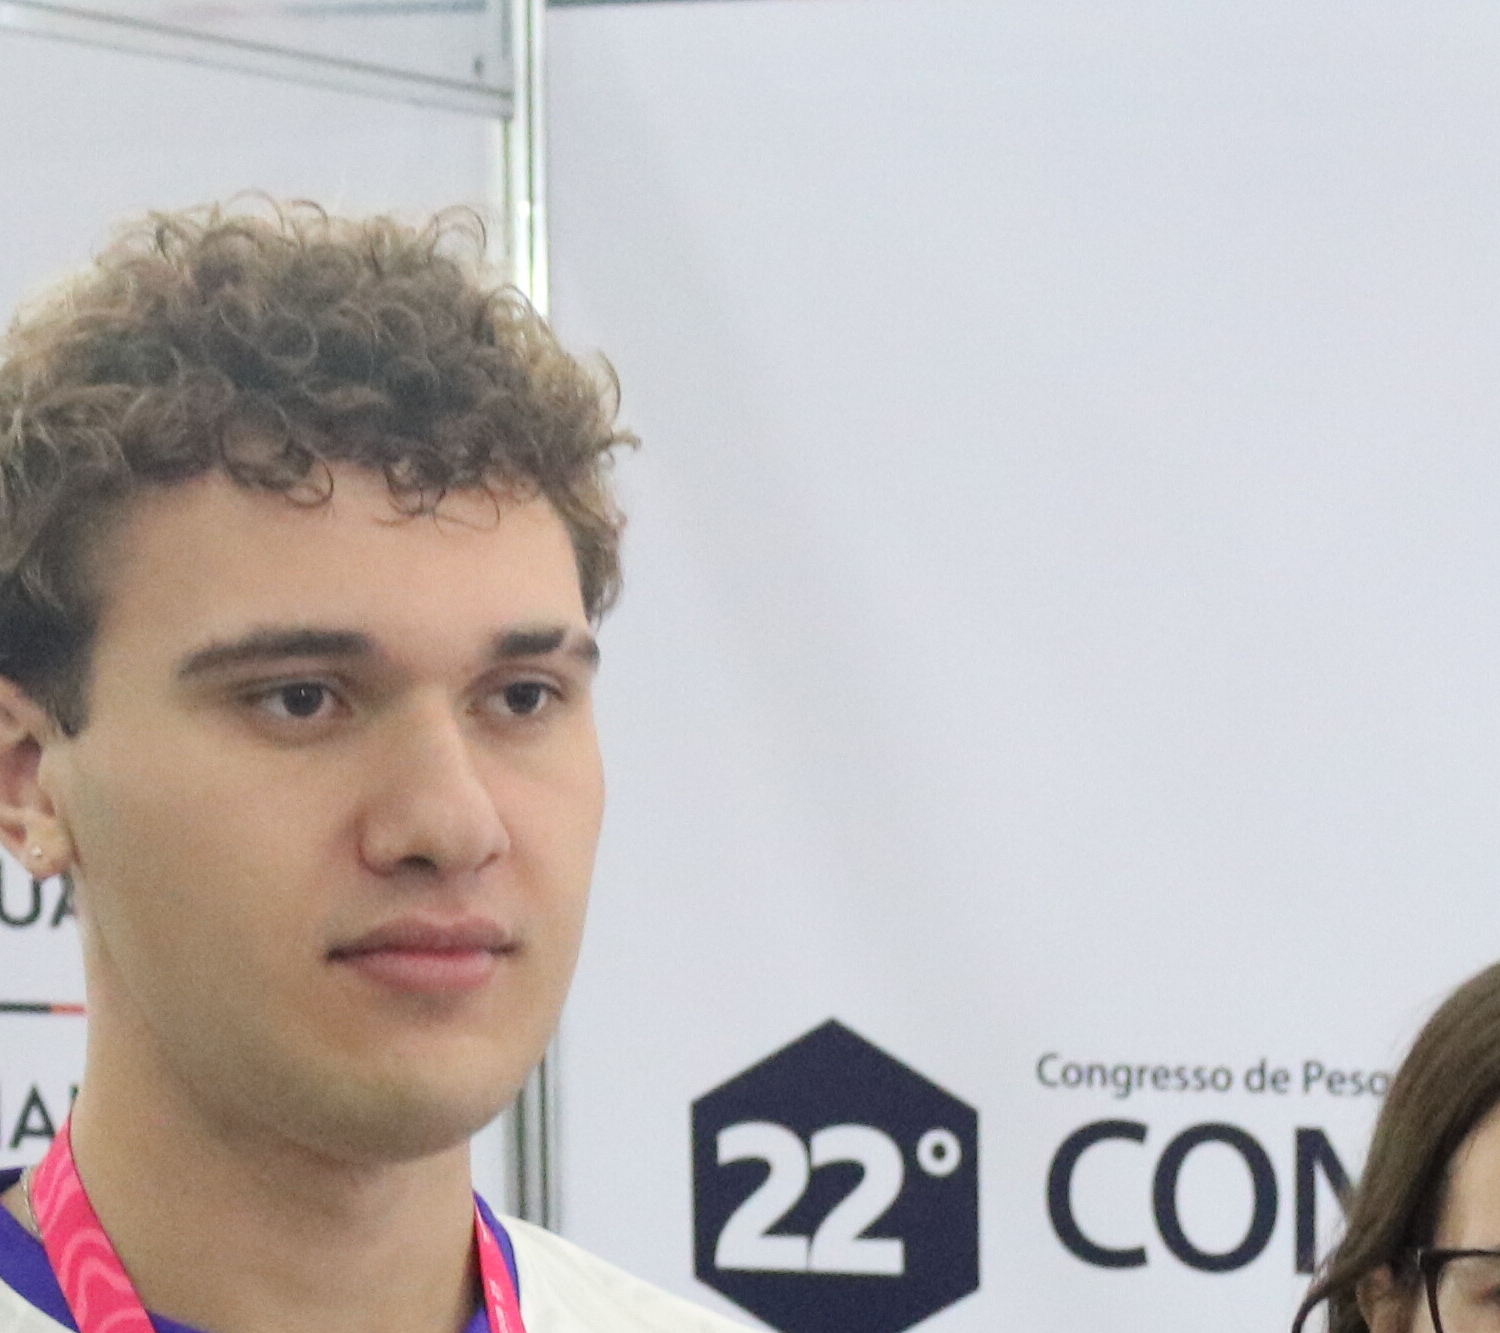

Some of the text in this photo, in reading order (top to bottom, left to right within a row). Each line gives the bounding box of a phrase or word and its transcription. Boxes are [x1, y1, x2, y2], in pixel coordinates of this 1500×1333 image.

[1036, 1052, 1233, 1099] Congresso
[1244, 1058, 1291, 1094] de
[1047, 1119, 1368, 1274] CON
